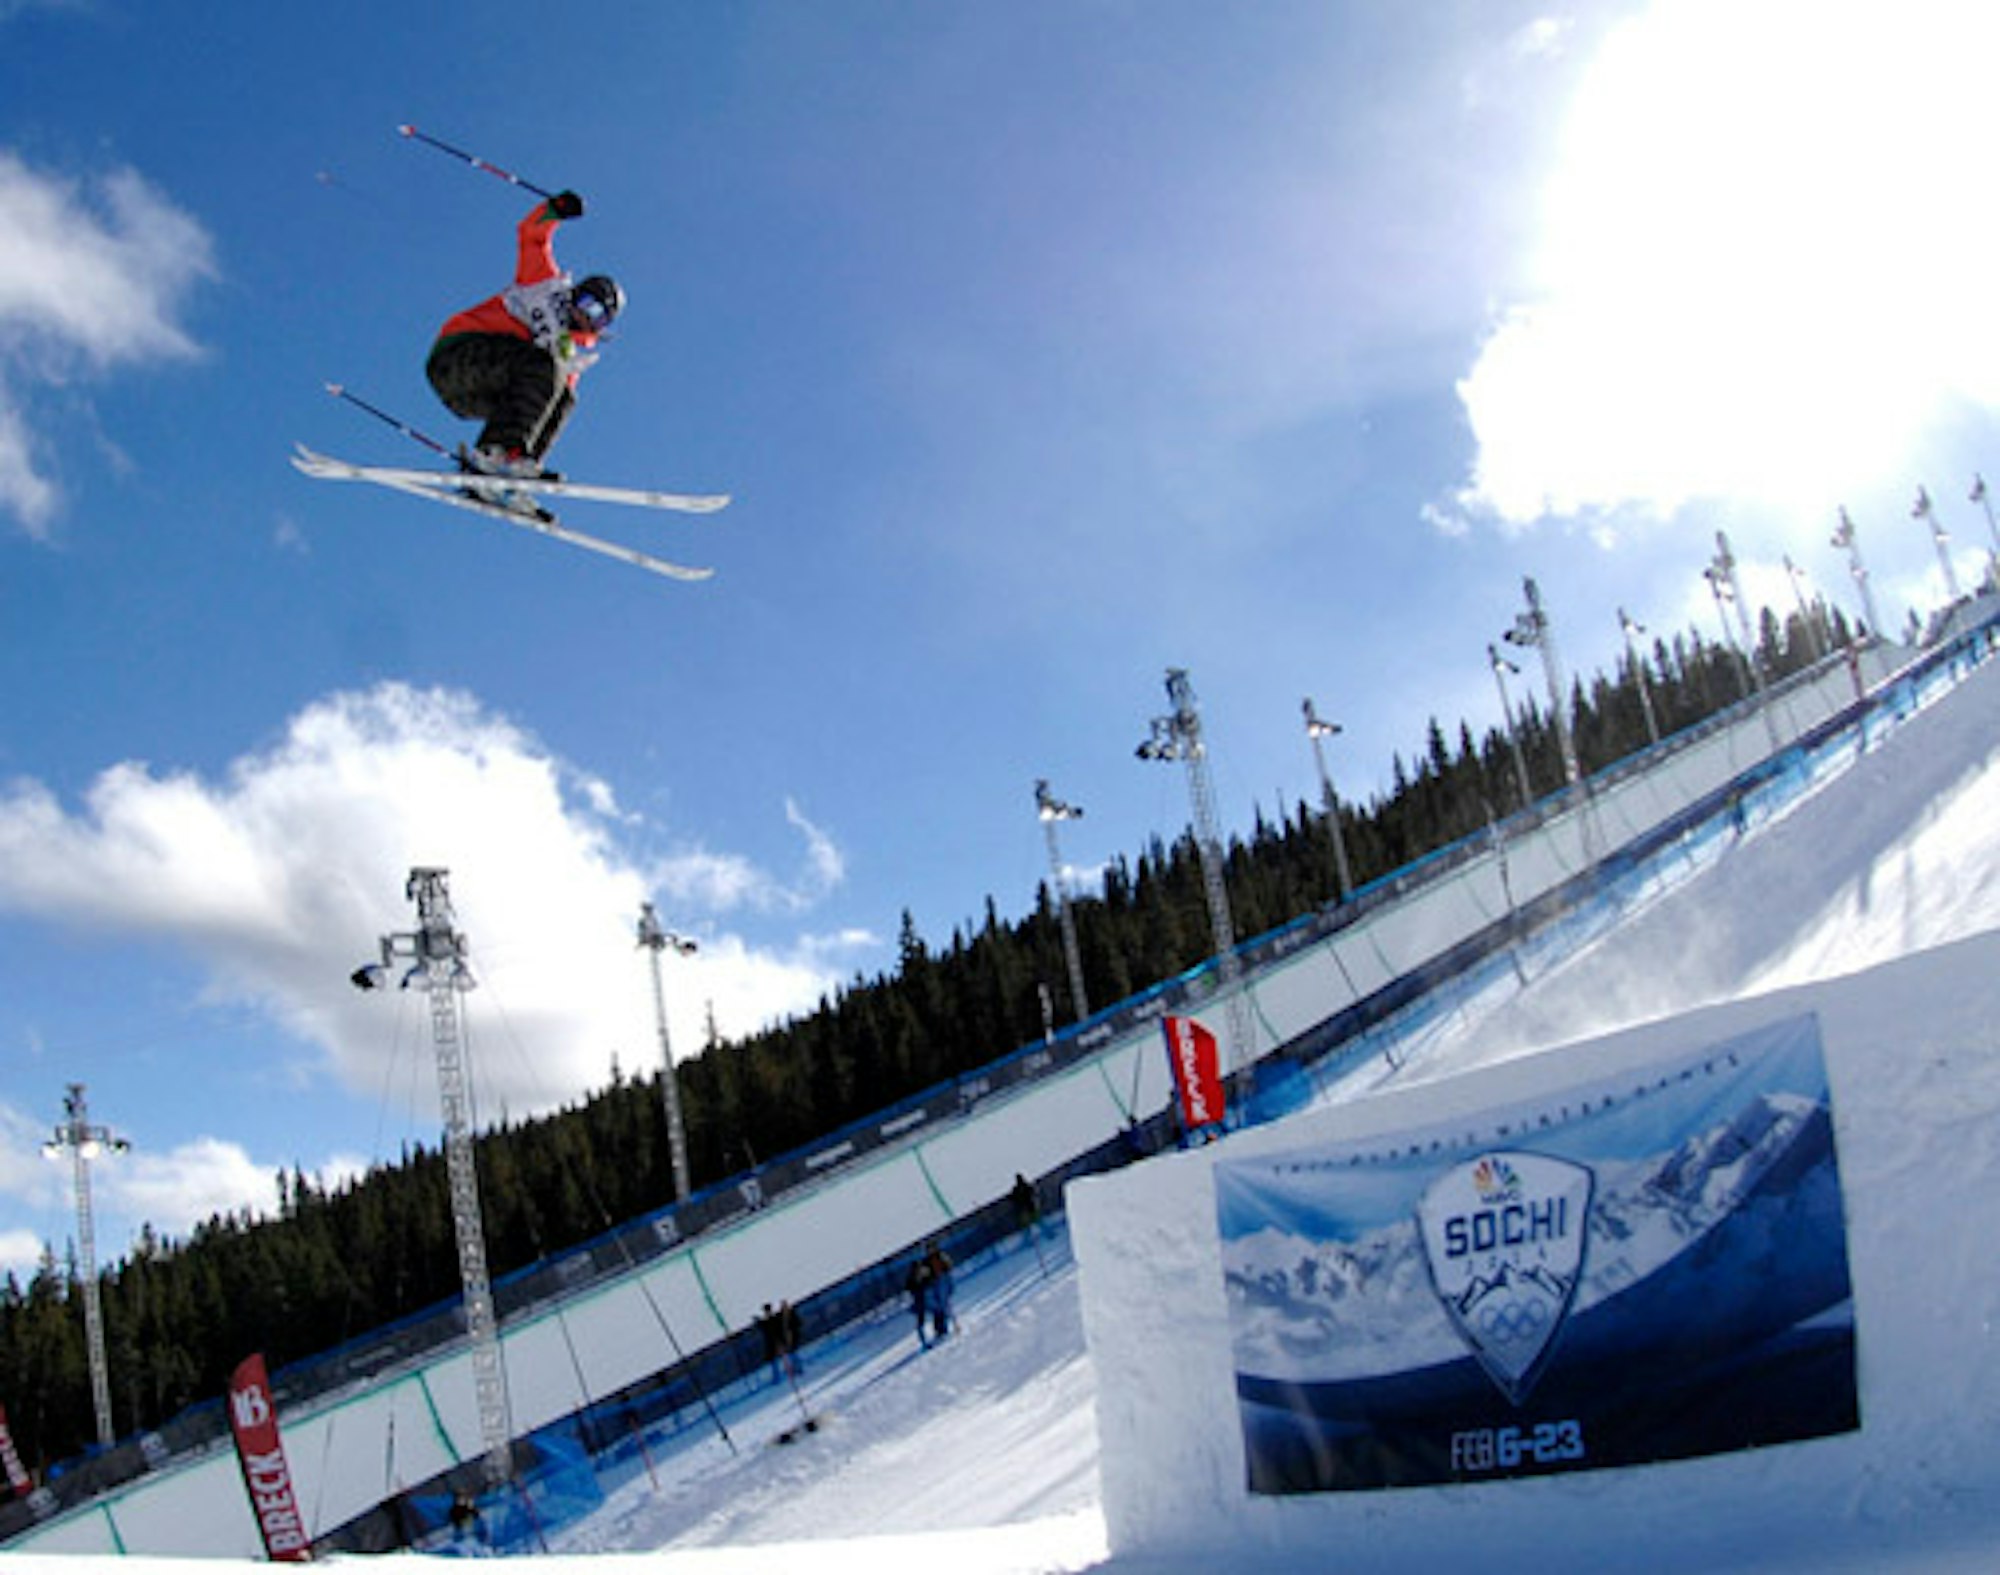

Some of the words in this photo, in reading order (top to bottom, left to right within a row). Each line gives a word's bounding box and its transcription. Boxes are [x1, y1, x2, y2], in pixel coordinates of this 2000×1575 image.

[1445, 1196, 1567, 1259] SOCHI
[1451, 1427, 1495, 1471] FEB
[1497, 1419, 1585, 1467] 6-23
[246, 1448, 304, 1552] BRECK
